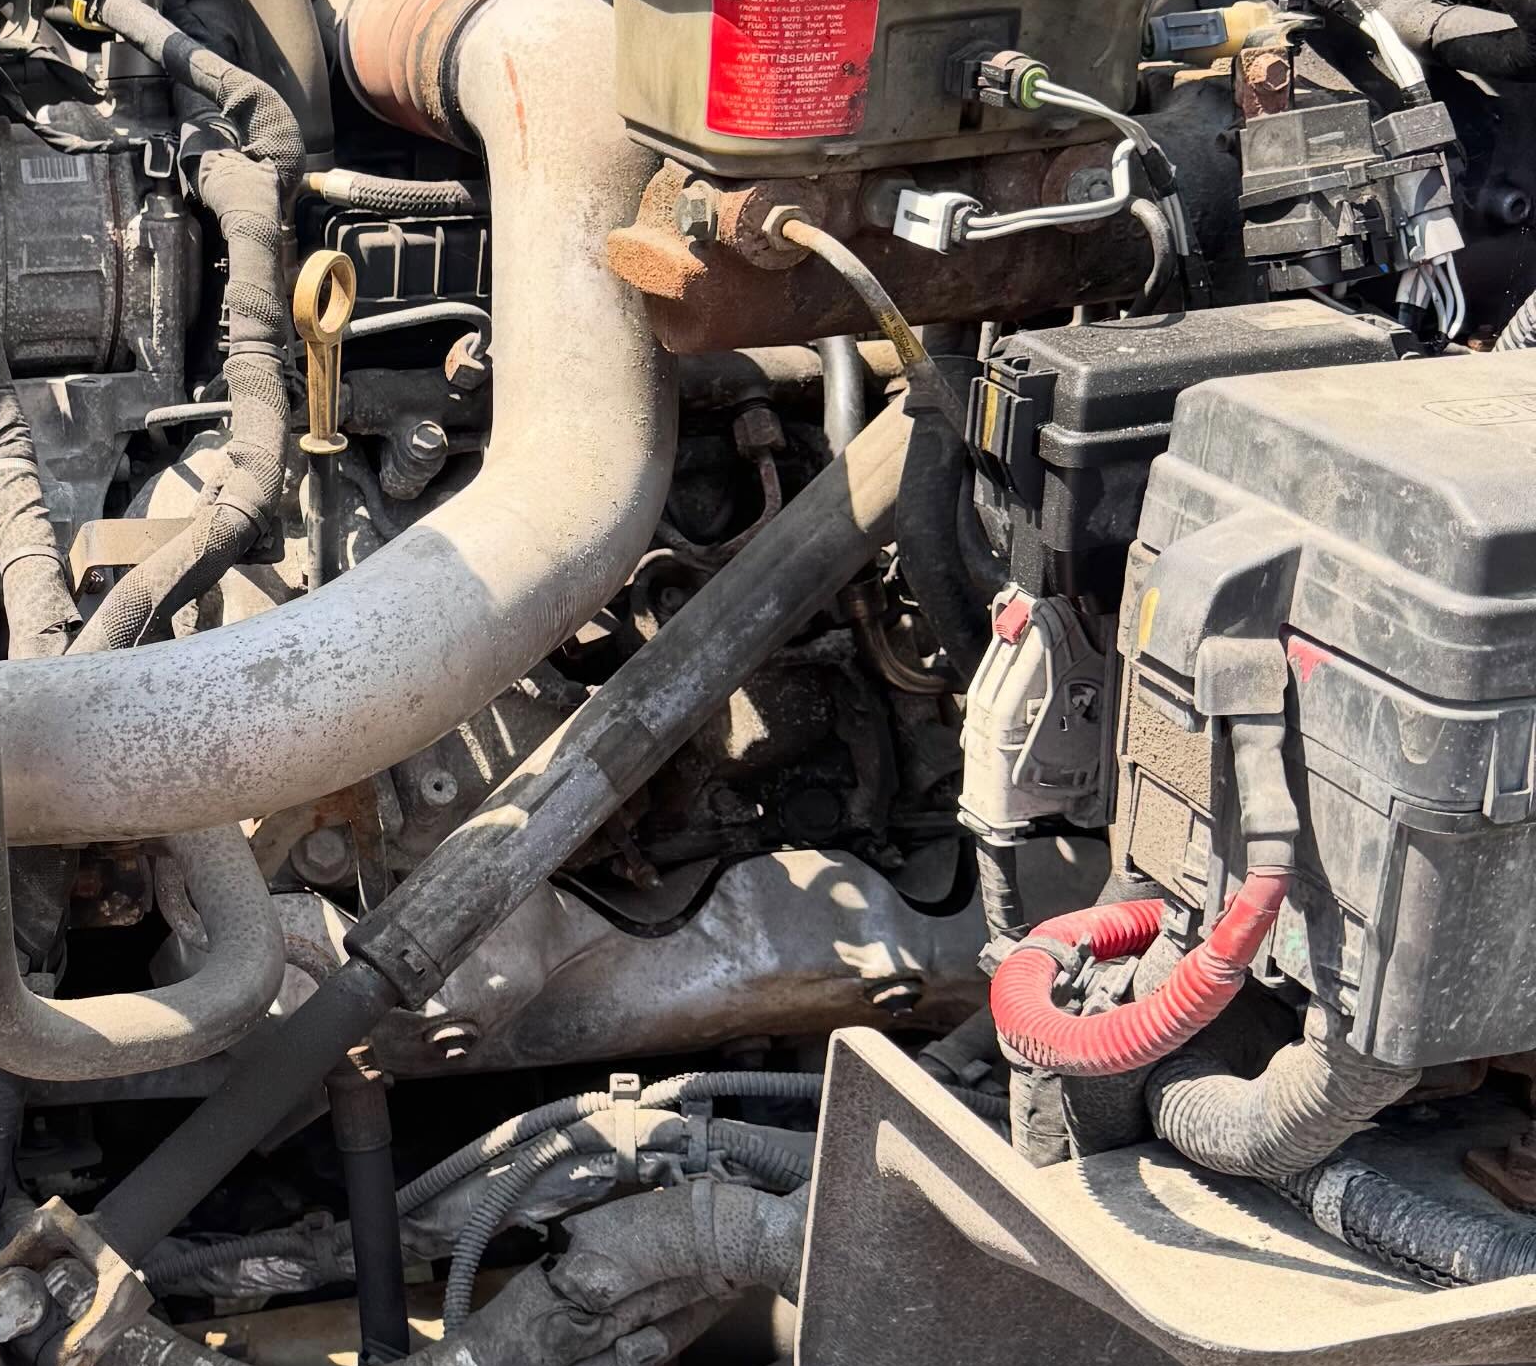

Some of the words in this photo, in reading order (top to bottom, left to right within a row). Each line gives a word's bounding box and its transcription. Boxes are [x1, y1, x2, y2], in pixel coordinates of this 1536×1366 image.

[803, 4, 846, 12] CONTAINER
[736, 51, 839, 63] AVERTISSEMENT
[770, 65, 814, 74] COUVERCLE
[796, 71, 839, 80] SEULEMENT
[790, 79, 833, 87] PROVENANT
